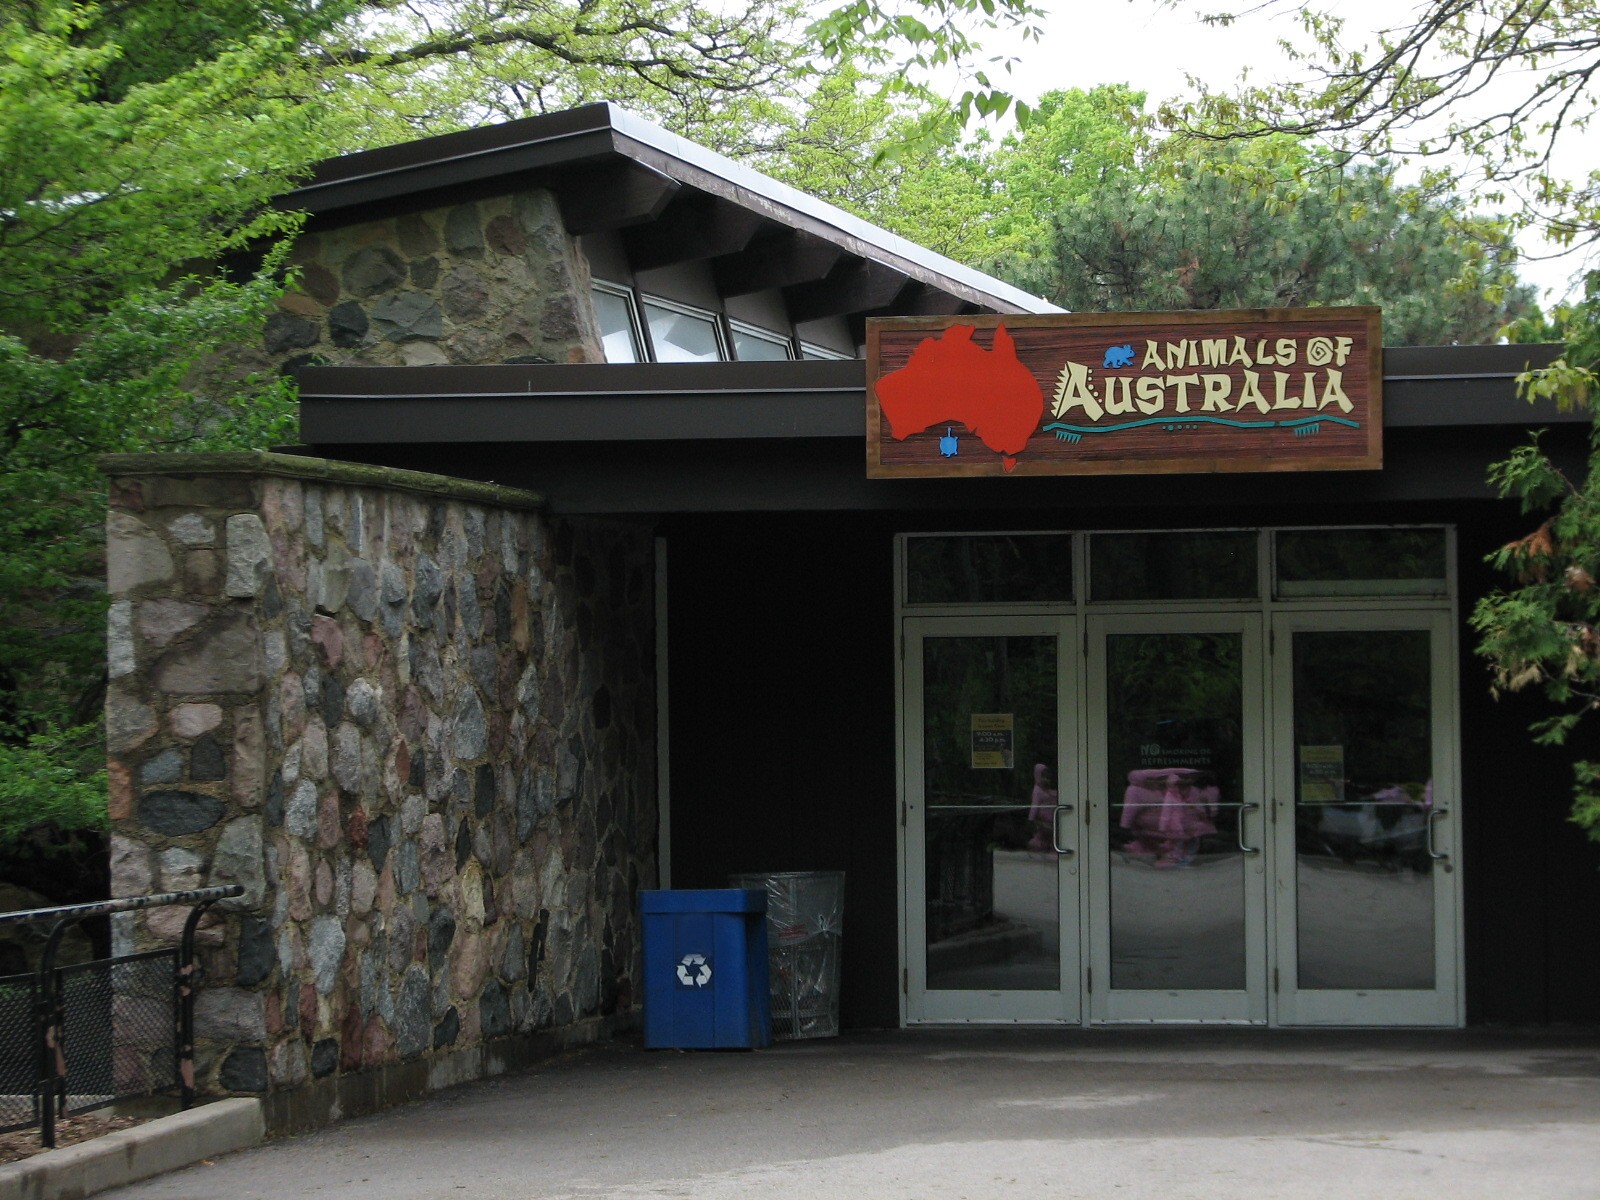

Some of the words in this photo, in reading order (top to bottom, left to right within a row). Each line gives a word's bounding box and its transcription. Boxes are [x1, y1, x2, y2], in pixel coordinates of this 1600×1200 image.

[1141, 335, 1297, 371] ANIMALS
[1307, 336, 1353, 367] OF
[1053, 361, 1354, 422] AUSTRALIA
[1140, 743, 1160, 756] NO
